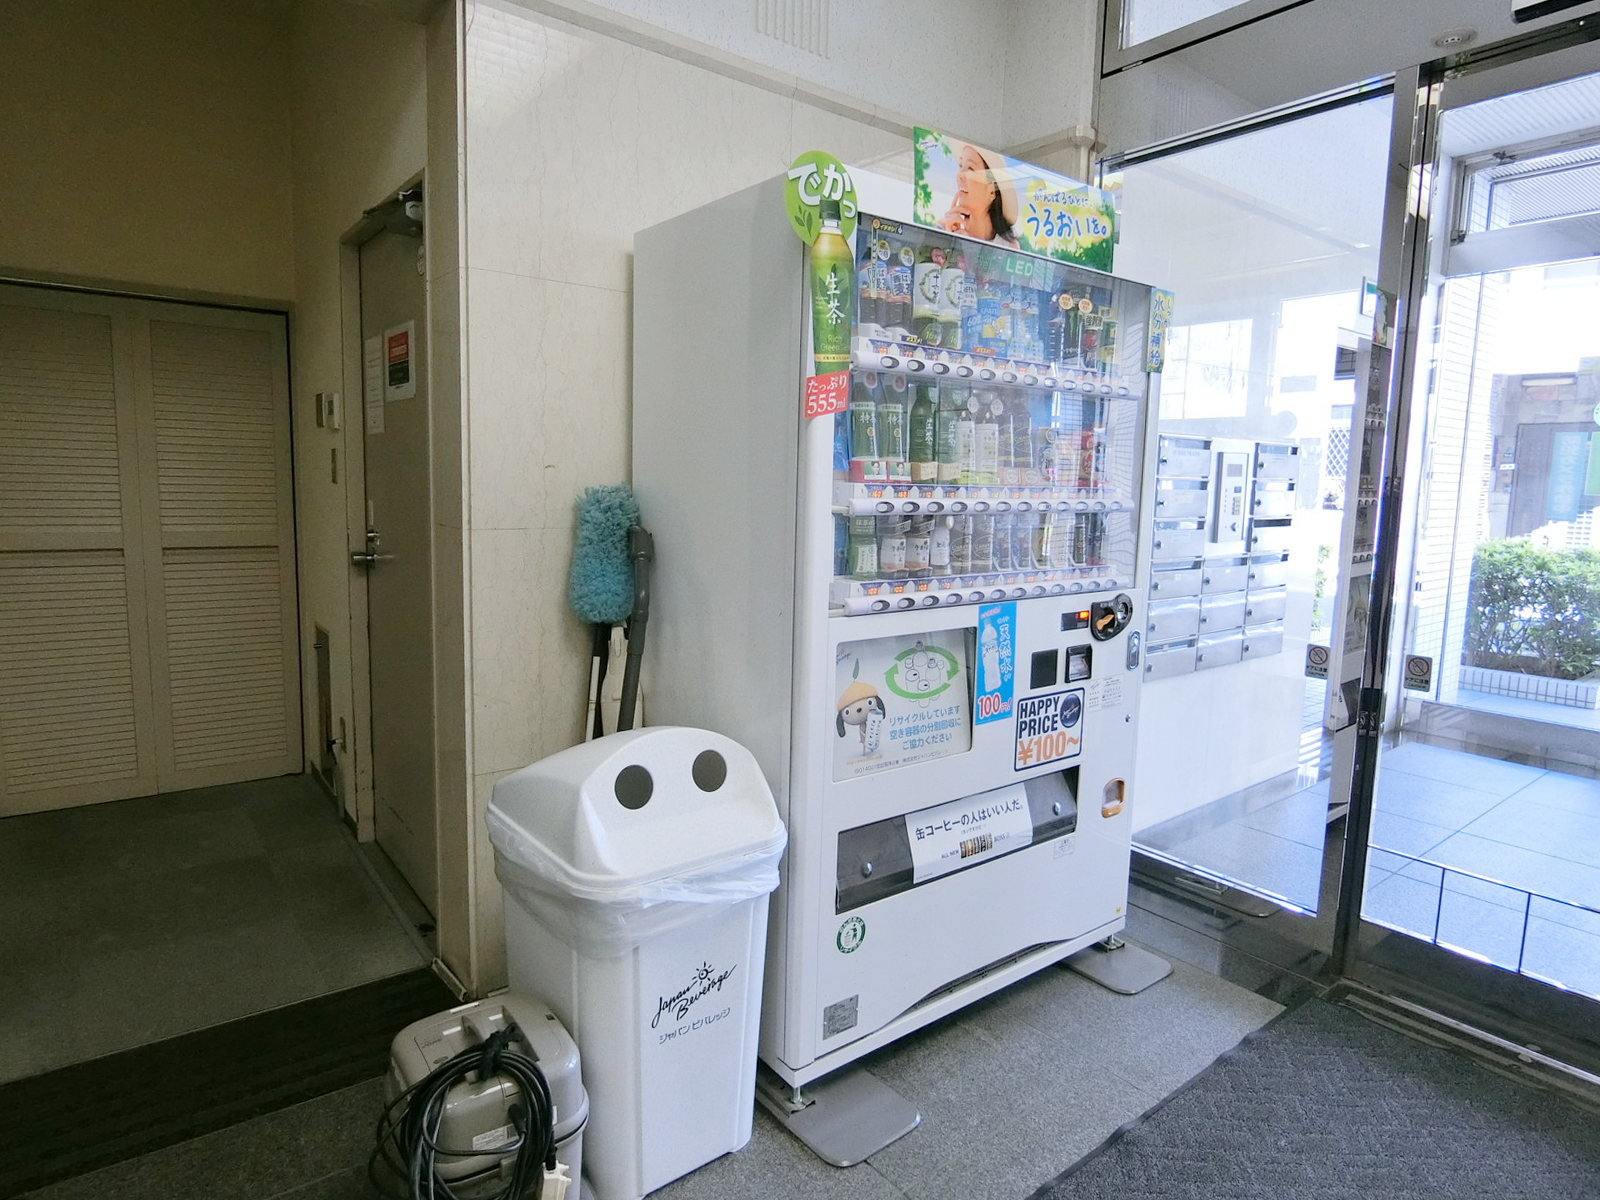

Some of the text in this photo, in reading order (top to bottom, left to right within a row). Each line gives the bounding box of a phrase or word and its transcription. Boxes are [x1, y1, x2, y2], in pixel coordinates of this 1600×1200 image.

[788, 163, 856, 219] でかっ
[1027, 203, 1107, 237] うるおいを。
[1006, 258, 1033, 276] LED
[825, 272, 845, 325] 生茶
[1149, 296, 1165, 366] 水分補給
[807, 375, 847, 394] たっぷり
[807, 392, 846, 415] 555ml
[889, 705, 961, 727] リサイクルしています
[1020, 696, 1060, 719] HAPPY
[889, 718, 962, 740] 空き容器の分別回収に
[1019, 714, 1058, 739] PRICE
[902, 733, 953, 750] ご協力ください
[915, 798, 1024, 841] 缶コーヒーの人はいい人だ。
[651, 979, 698, 1028] Japan
[672, 964, 737, 1021] Beverage
[659, 1007, 731, 1044] ジャパンビバレッジ
